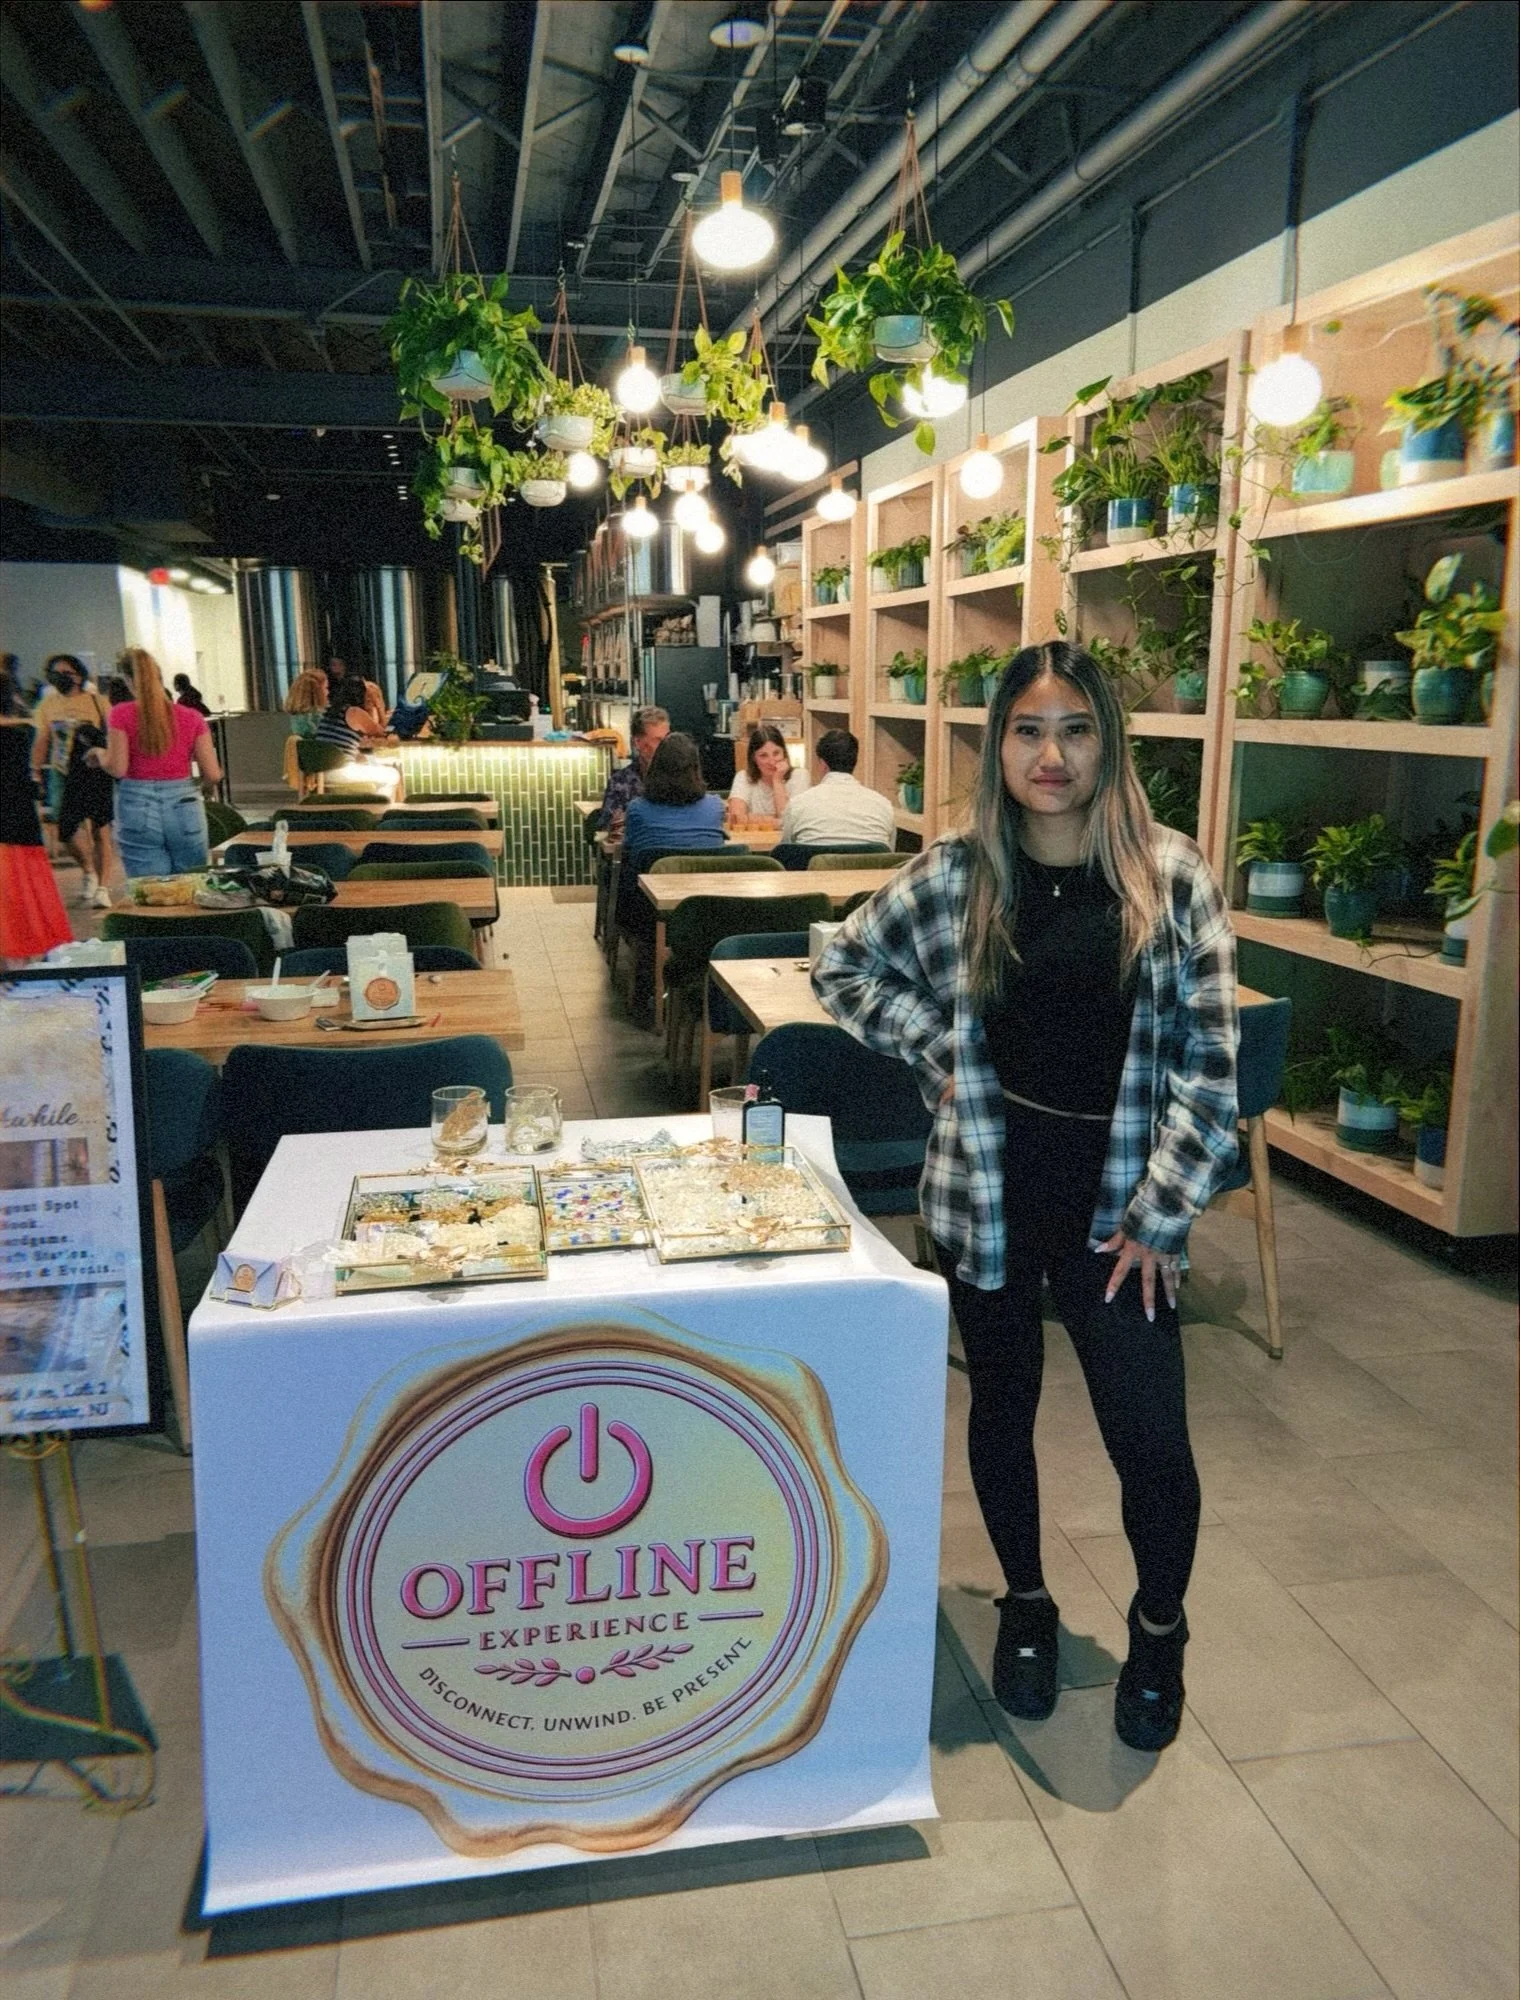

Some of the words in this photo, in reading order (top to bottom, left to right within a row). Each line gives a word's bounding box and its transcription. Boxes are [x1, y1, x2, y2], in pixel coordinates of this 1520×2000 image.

[44, 1199, 79, 1213] Spot
[400, 1536, 757, 1619] OFFLINE
[478, 1612, 690, 1651] EXPERIENCE
[419, 1667, 535, 1731] DISCONNECT.
[543, 1708, 637, 1732] UNWIND.
[642, 1696, 668, 1715] BE
